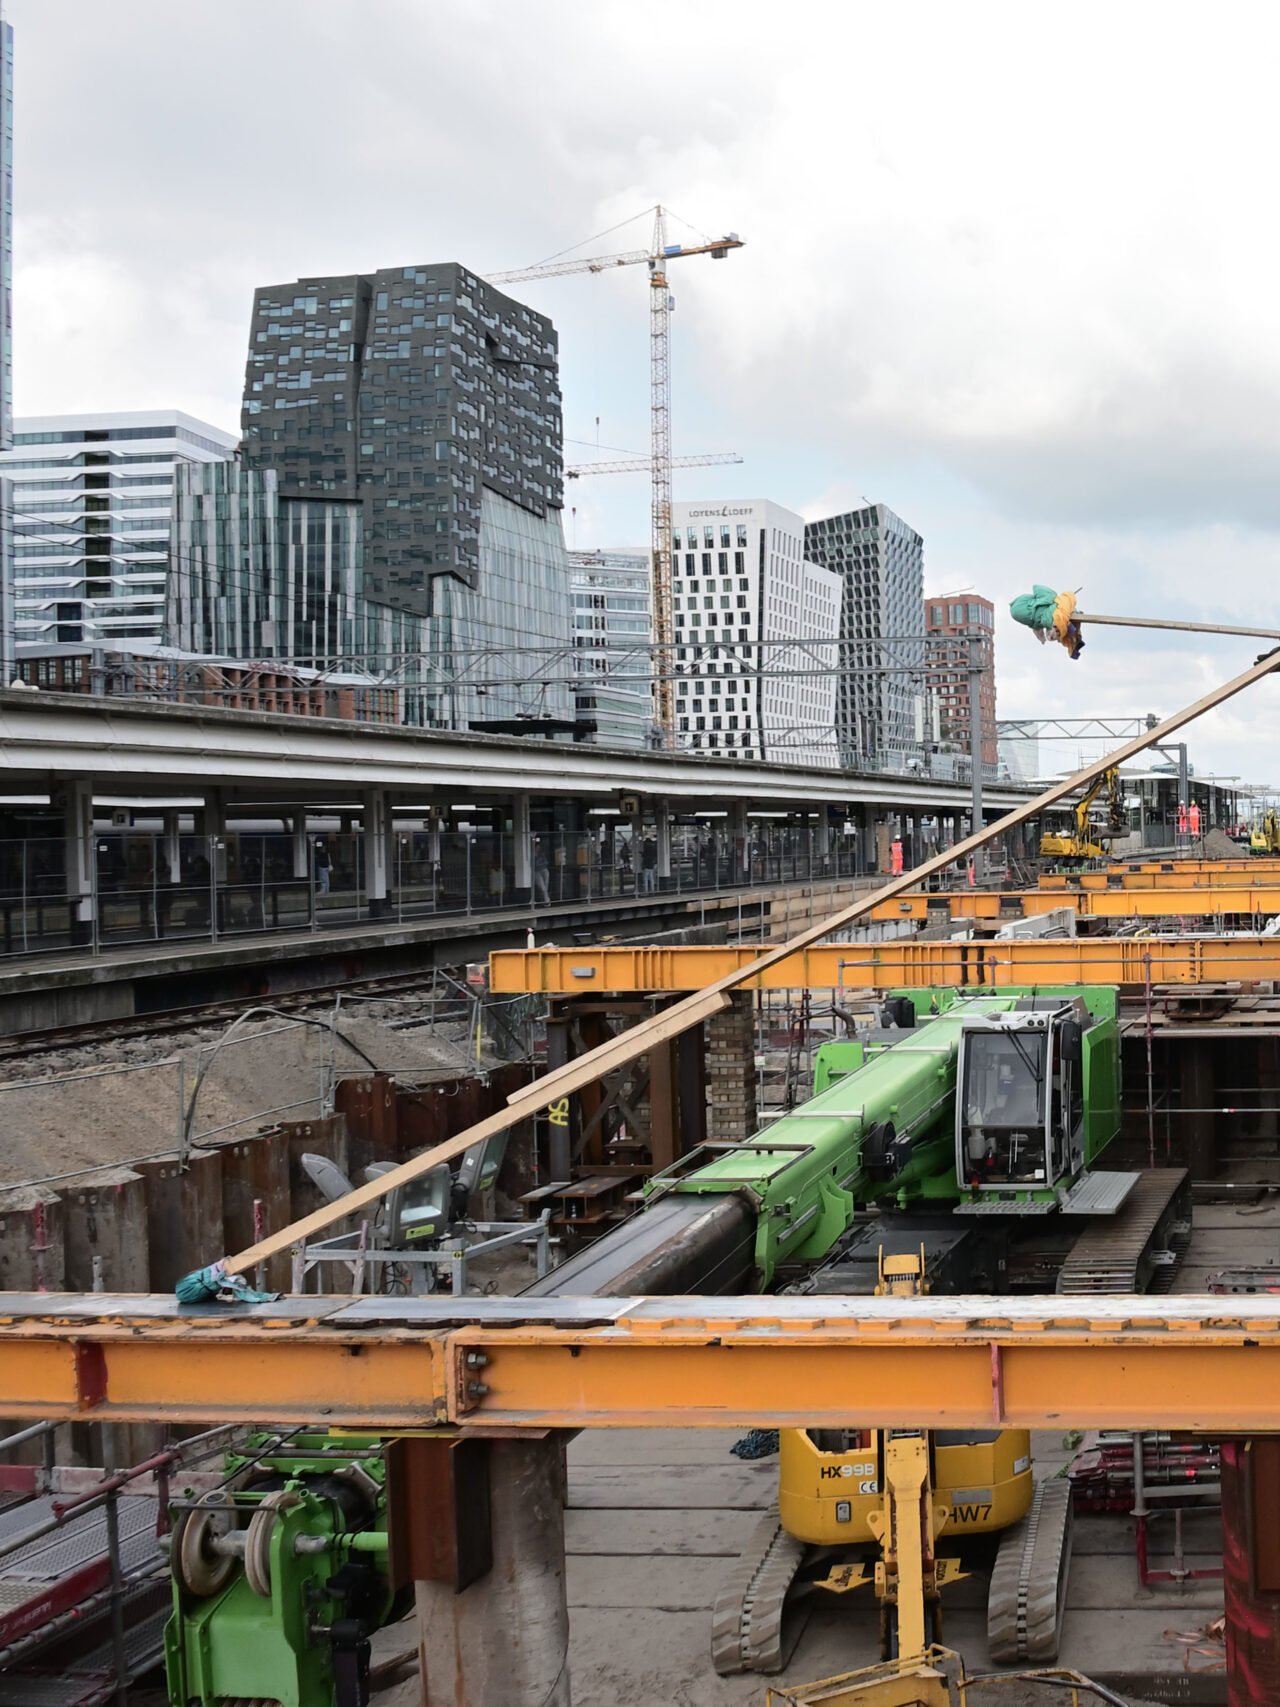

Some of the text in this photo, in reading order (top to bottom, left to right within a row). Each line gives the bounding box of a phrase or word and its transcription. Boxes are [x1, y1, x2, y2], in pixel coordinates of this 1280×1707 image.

[688, 509, 720, 518] LOYENS
[728, 507, 753, 516] LOEFF
[821, 1463, 875, 1479] HX99B
[860, 1481, 877, 1493] CE
